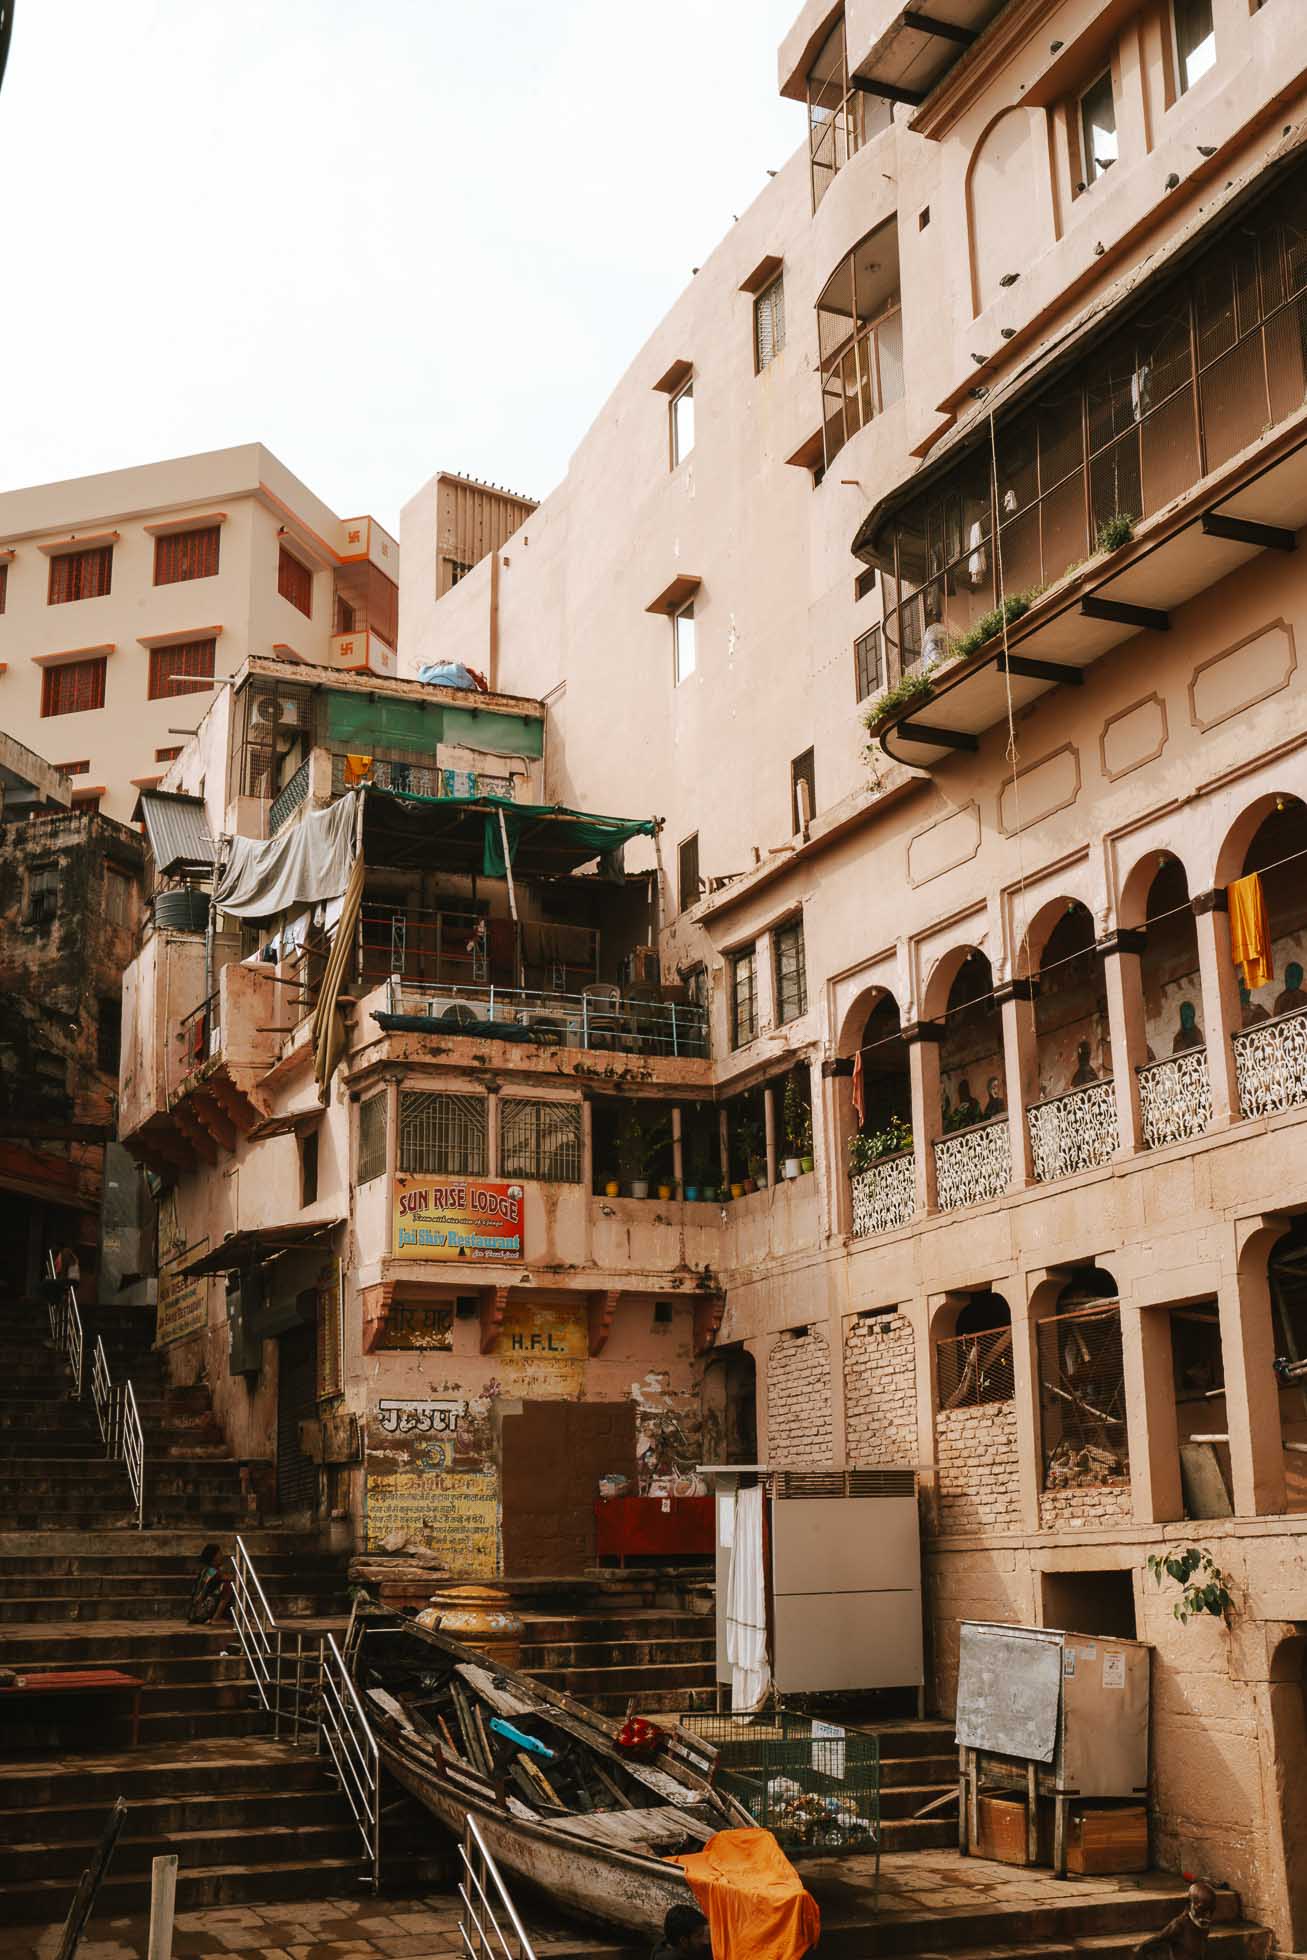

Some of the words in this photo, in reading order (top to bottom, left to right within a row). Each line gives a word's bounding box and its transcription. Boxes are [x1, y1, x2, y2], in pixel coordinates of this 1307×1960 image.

[399, 1187, 430, 1217] SUN
[433, 1186, 466, 1212] RISE
[470, 1188, 519, 1224] LODGE
[399, 1227, 417, 1249] Jai
[418, 1227, 447, 1247] Shiv
[448, 1230, 520, 1250] Restaurant
